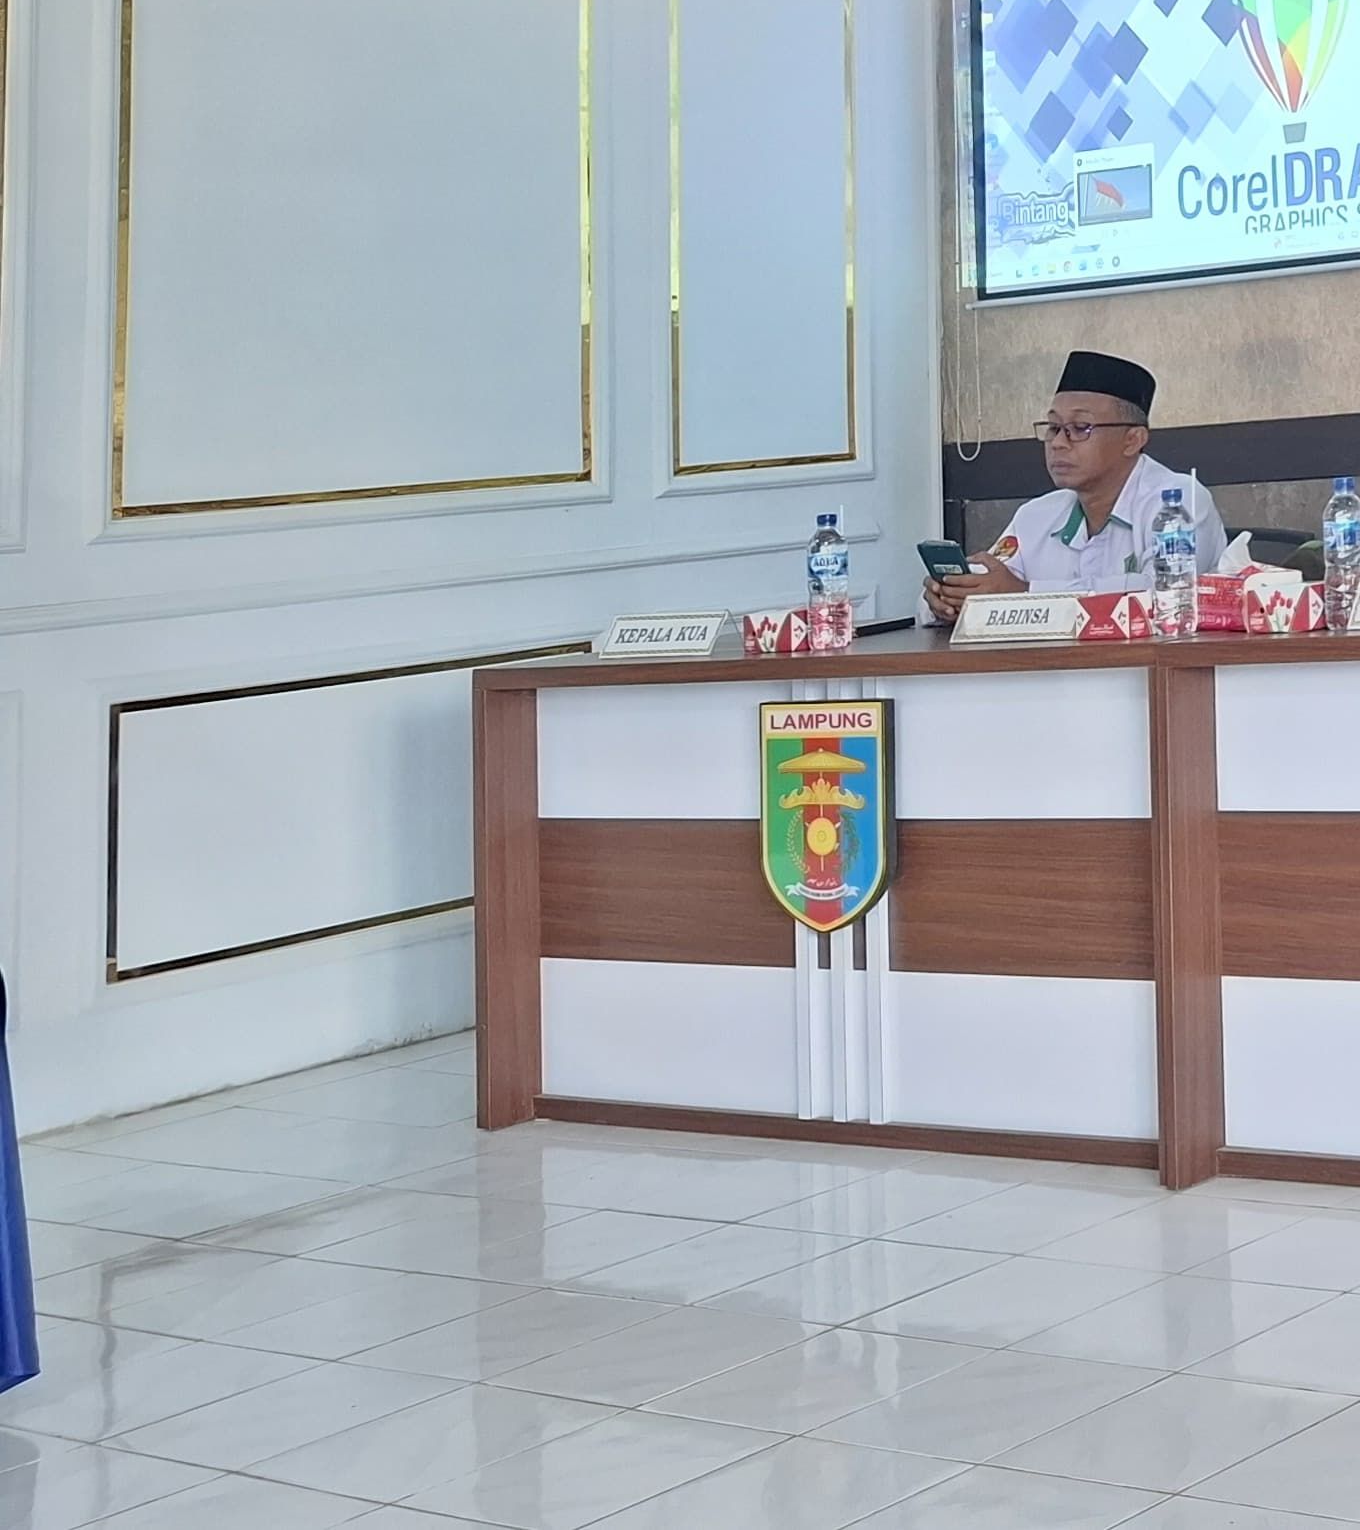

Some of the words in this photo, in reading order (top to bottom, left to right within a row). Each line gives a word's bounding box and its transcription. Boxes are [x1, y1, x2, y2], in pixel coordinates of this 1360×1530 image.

[1002, 200, 1069, 226] Bintang
[985, 606, 1051, 627] BABINSA
[614, 625, 672, 646] KEPALA
[675, 623, 708, 642] KUA
[769, 712, 873, 731] LAMPUNG
